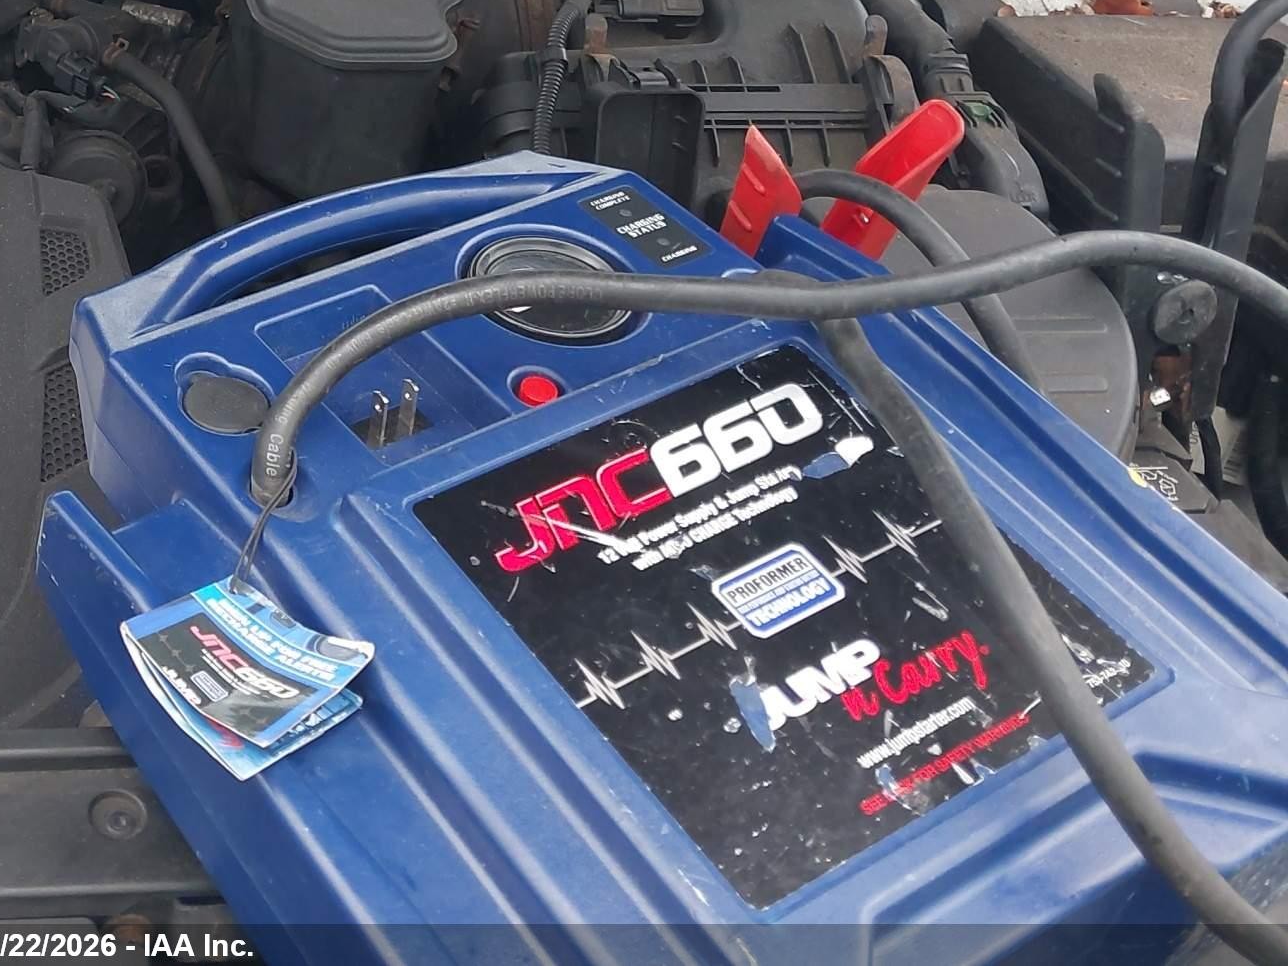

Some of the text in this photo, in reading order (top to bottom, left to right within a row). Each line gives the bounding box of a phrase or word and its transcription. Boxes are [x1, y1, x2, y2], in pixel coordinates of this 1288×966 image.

[616, 213, 665, 234] CHARGING
[627, 221, 667, 238] STATUS
[661, 245, 698, 263] CHARGING
[266, 434, 284, 476] Cable
[637, 521, 678, 545] Power
[674, 501, 718, 528] Supply
[726, 482, 760, 505] Jump
[730, 486, 799, 522] Technology
[727, 557, 809, 604] PROFORMER
[857, 696, 976, 769] www.jumpstarter.com
